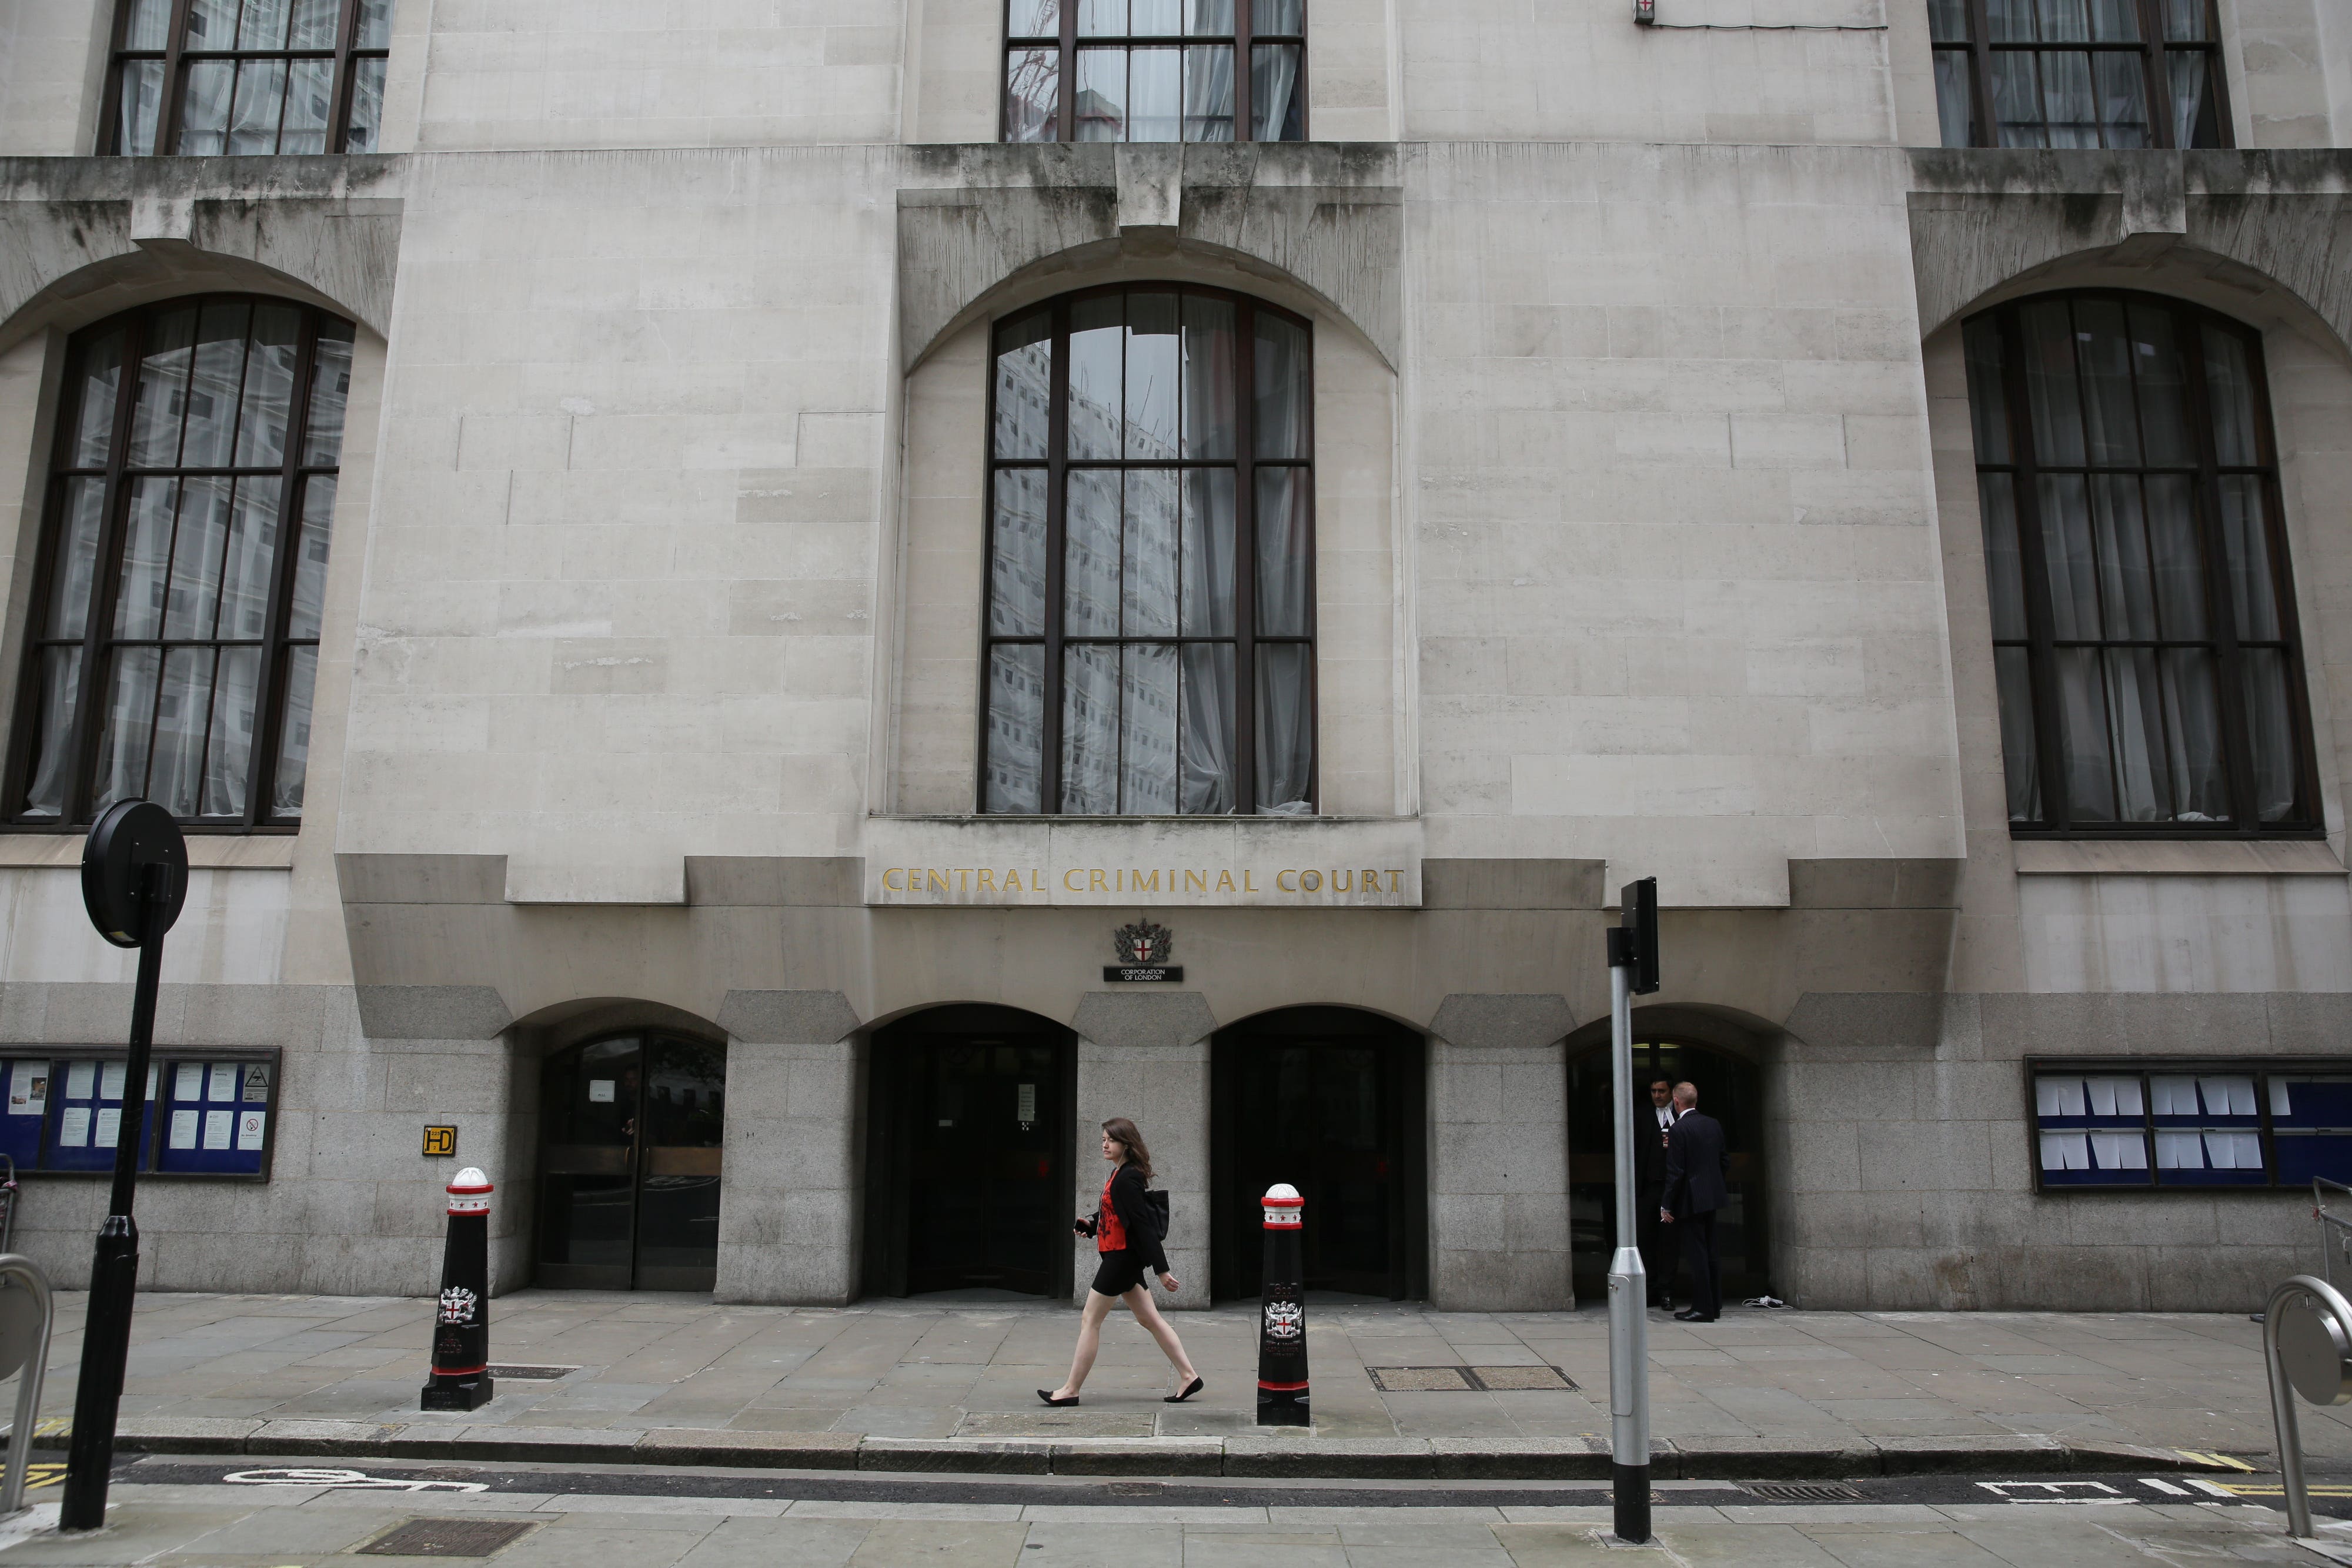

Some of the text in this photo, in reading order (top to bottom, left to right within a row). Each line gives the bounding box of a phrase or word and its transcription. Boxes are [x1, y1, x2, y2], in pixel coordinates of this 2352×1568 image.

[882, 868, 1405, 893] CENTRAL CRIMINAL COURT
[426, 1129, 453, 1152] HD
